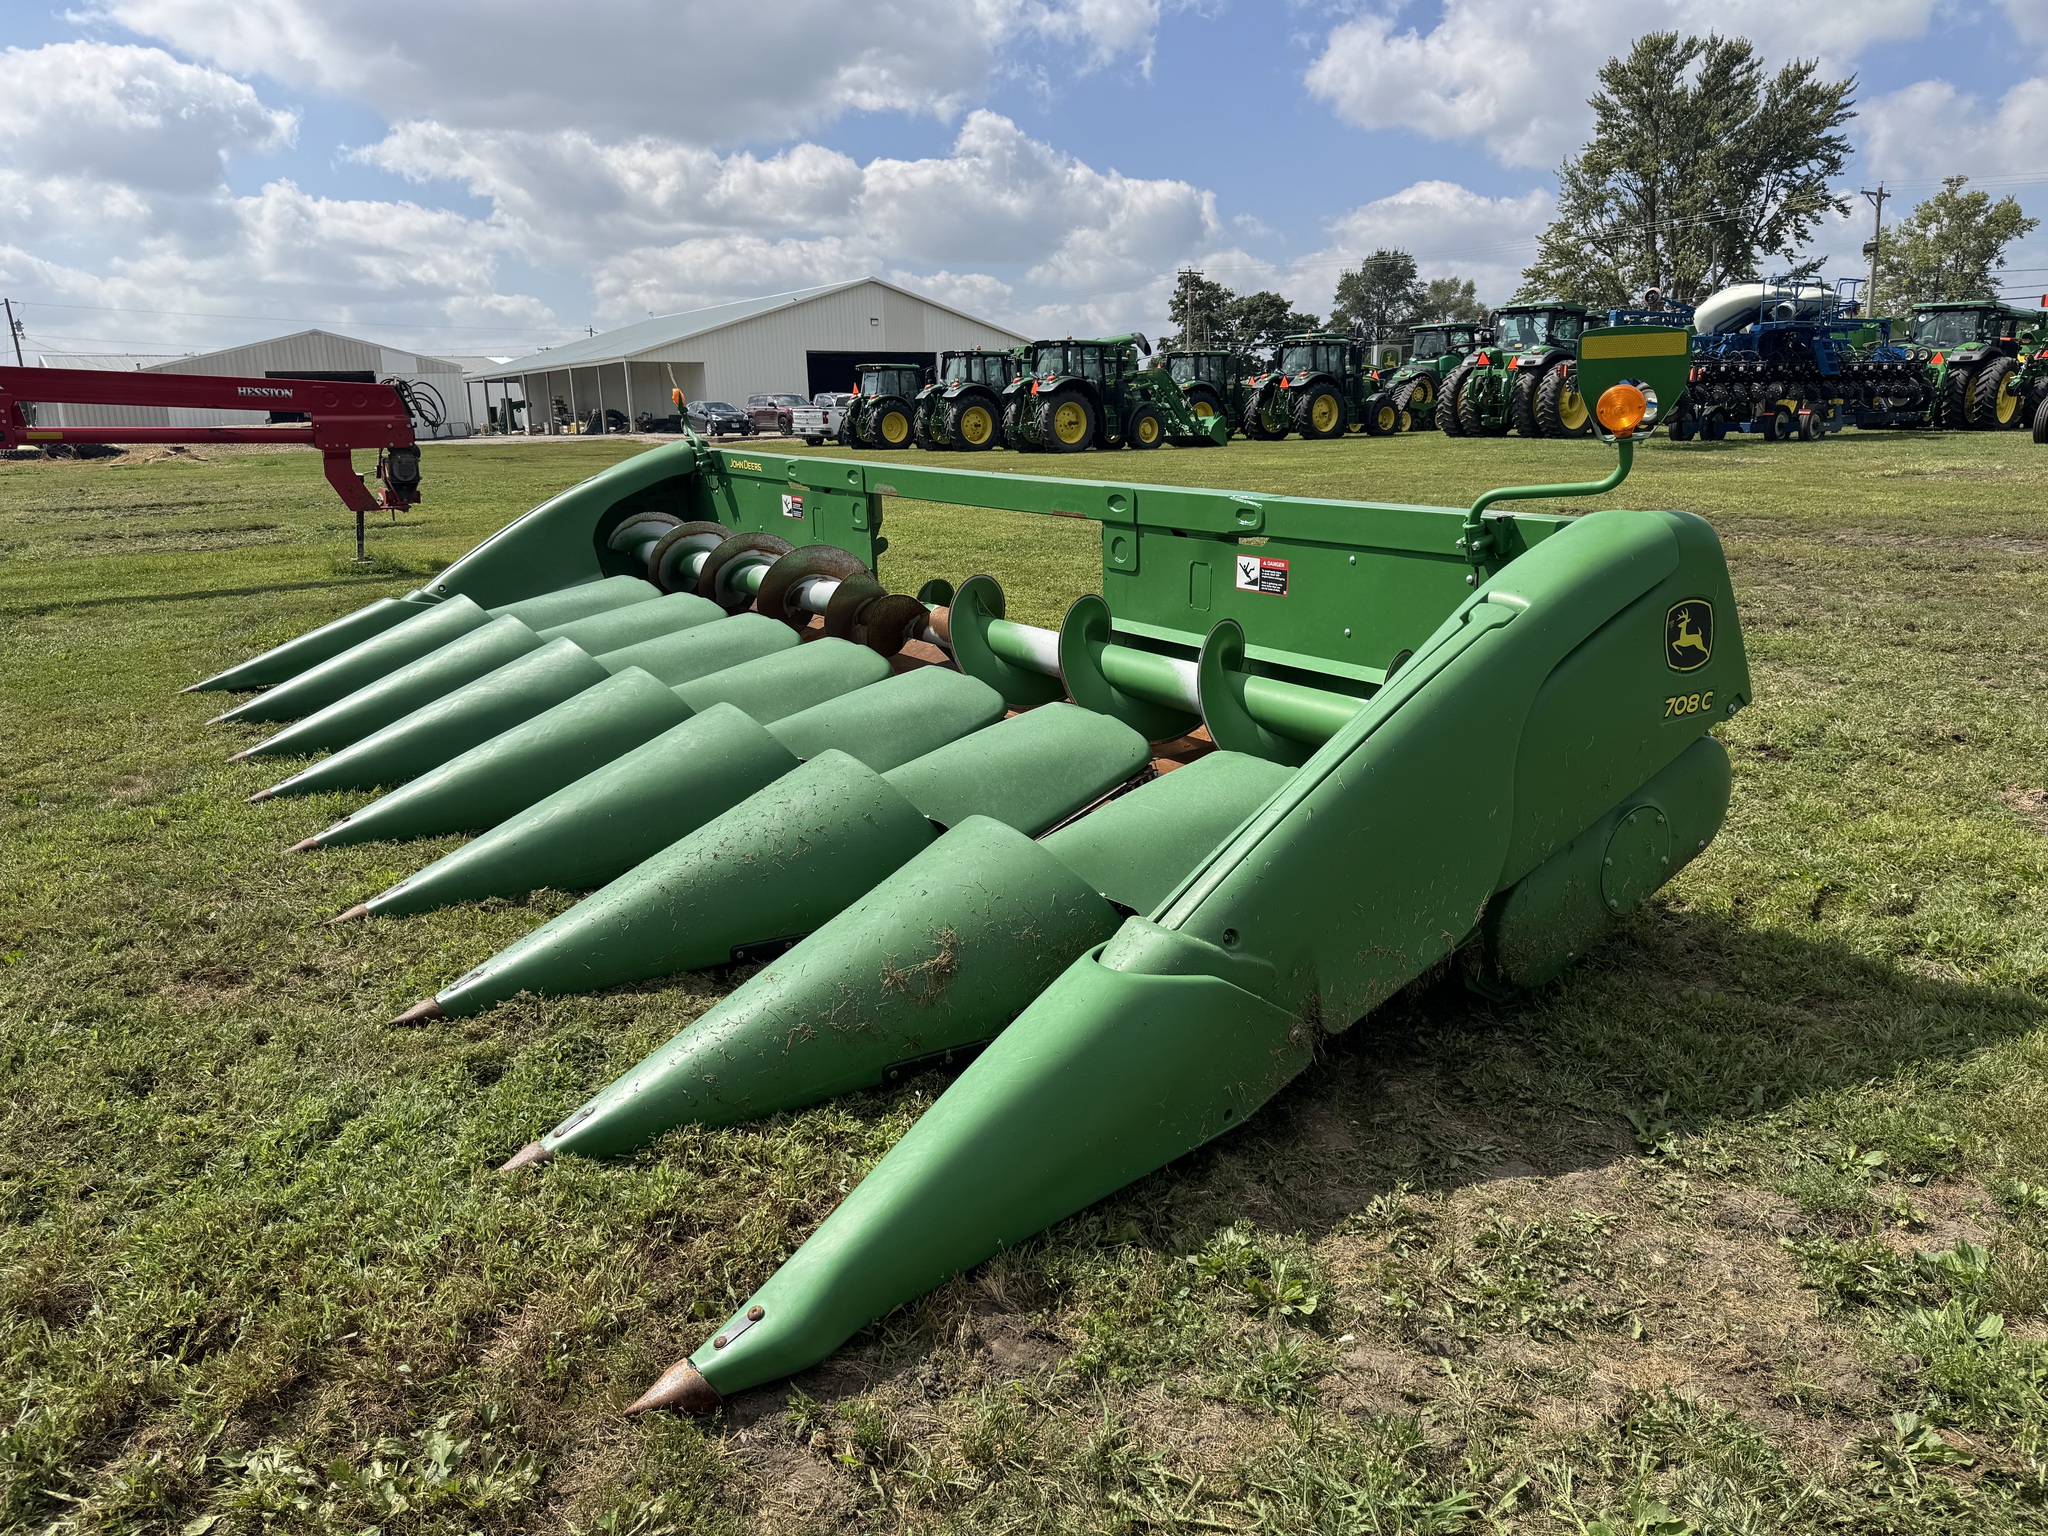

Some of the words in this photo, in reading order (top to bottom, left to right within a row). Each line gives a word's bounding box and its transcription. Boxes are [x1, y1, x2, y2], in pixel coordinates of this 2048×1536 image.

[237, 386, 293, 398] HESSTON
[730, 459, 744, 469] JOHN
[1267, 560, 1285, 568] DANGER
[1664, 693, 1700, 718] 708
[1701, 691, 1714, 711] C
